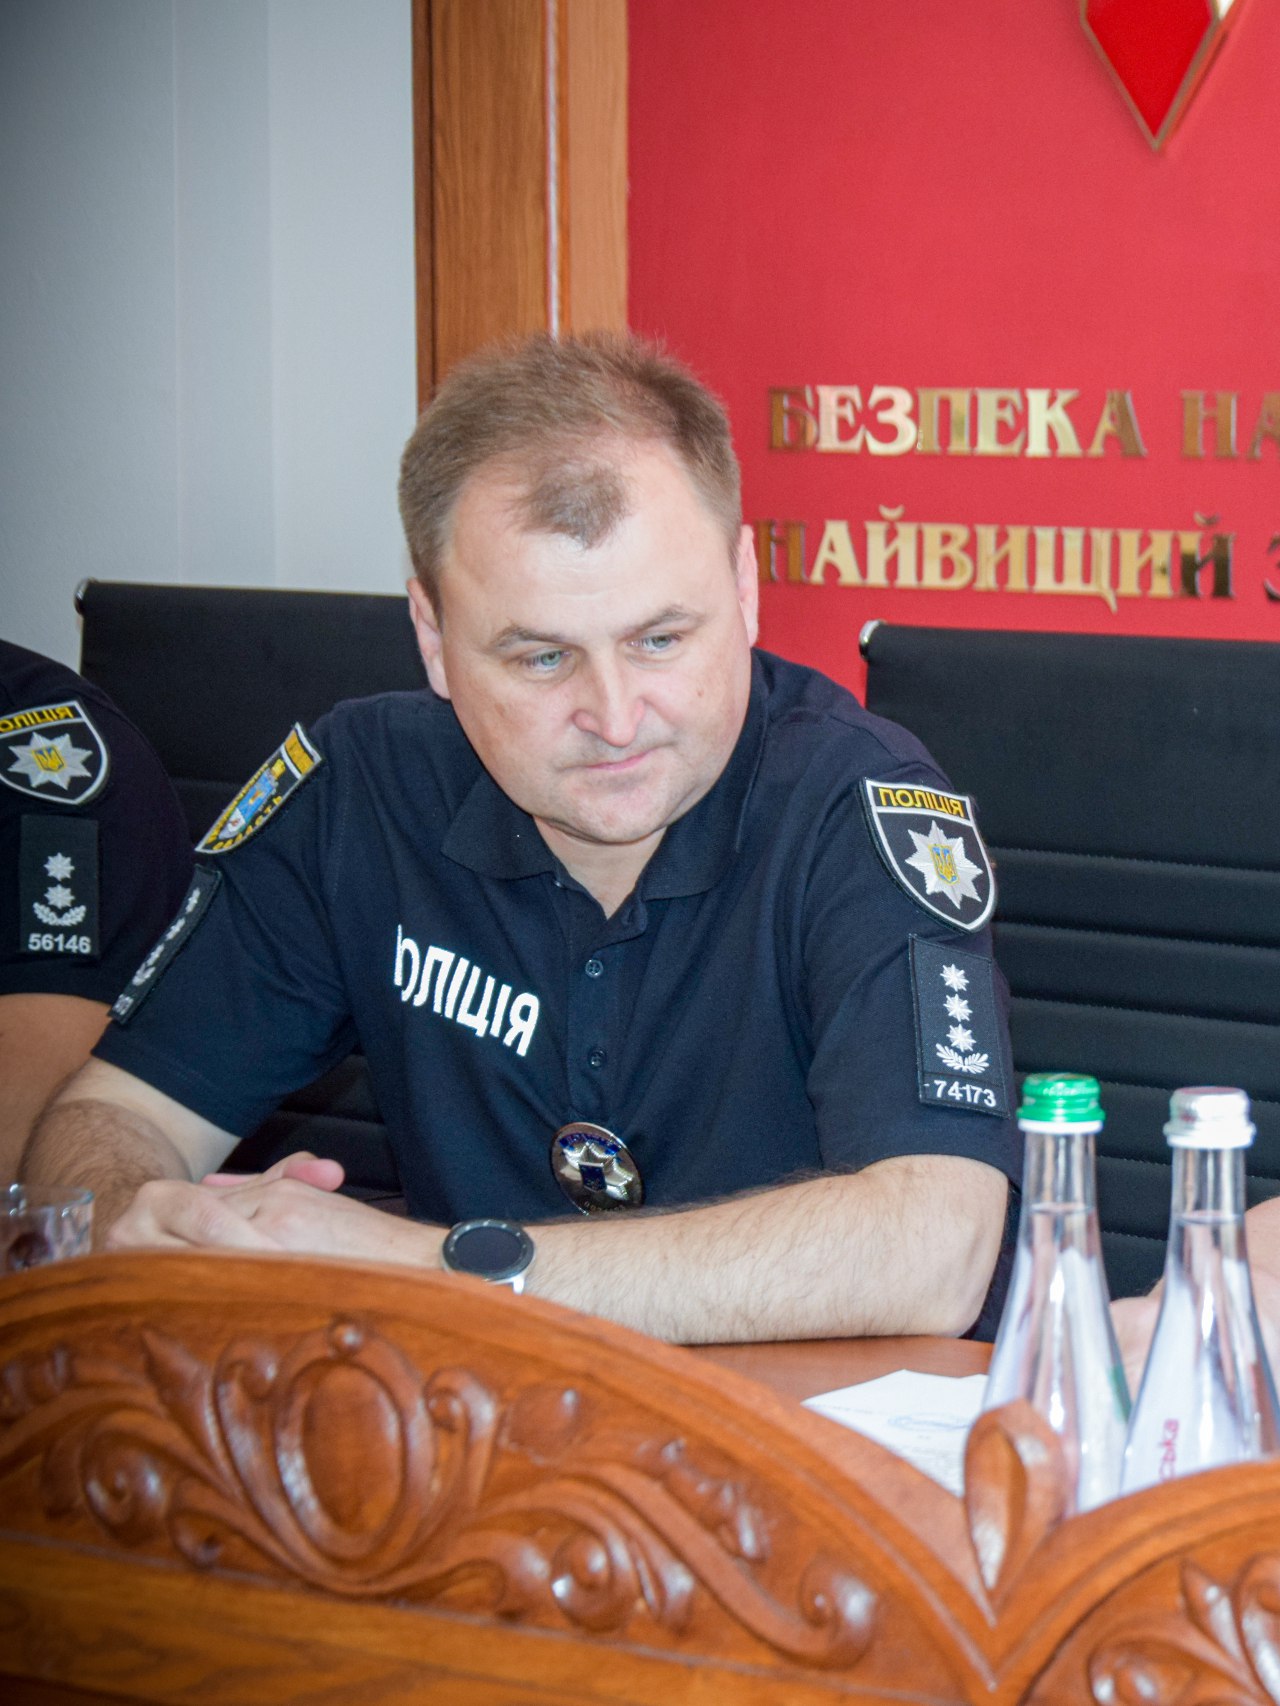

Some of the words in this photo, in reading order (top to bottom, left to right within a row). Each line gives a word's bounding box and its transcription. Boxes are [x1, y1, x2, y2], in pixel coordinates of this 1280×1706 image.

[768, 385, 1147, 457] БЕЗПЕКА
[757, 504, 1235, 613] НАЙВИЩИЙ
[0, 706, 74, 733] ОЛІЦІЯ
[878, 787, 965, 818] ПОЛІЦІЯ
[28, 933, 91, 954] 56146
[394, 924, 541, 1056] ОЛІЦІЯ
[933, 1079, 997, 1108] 74173
